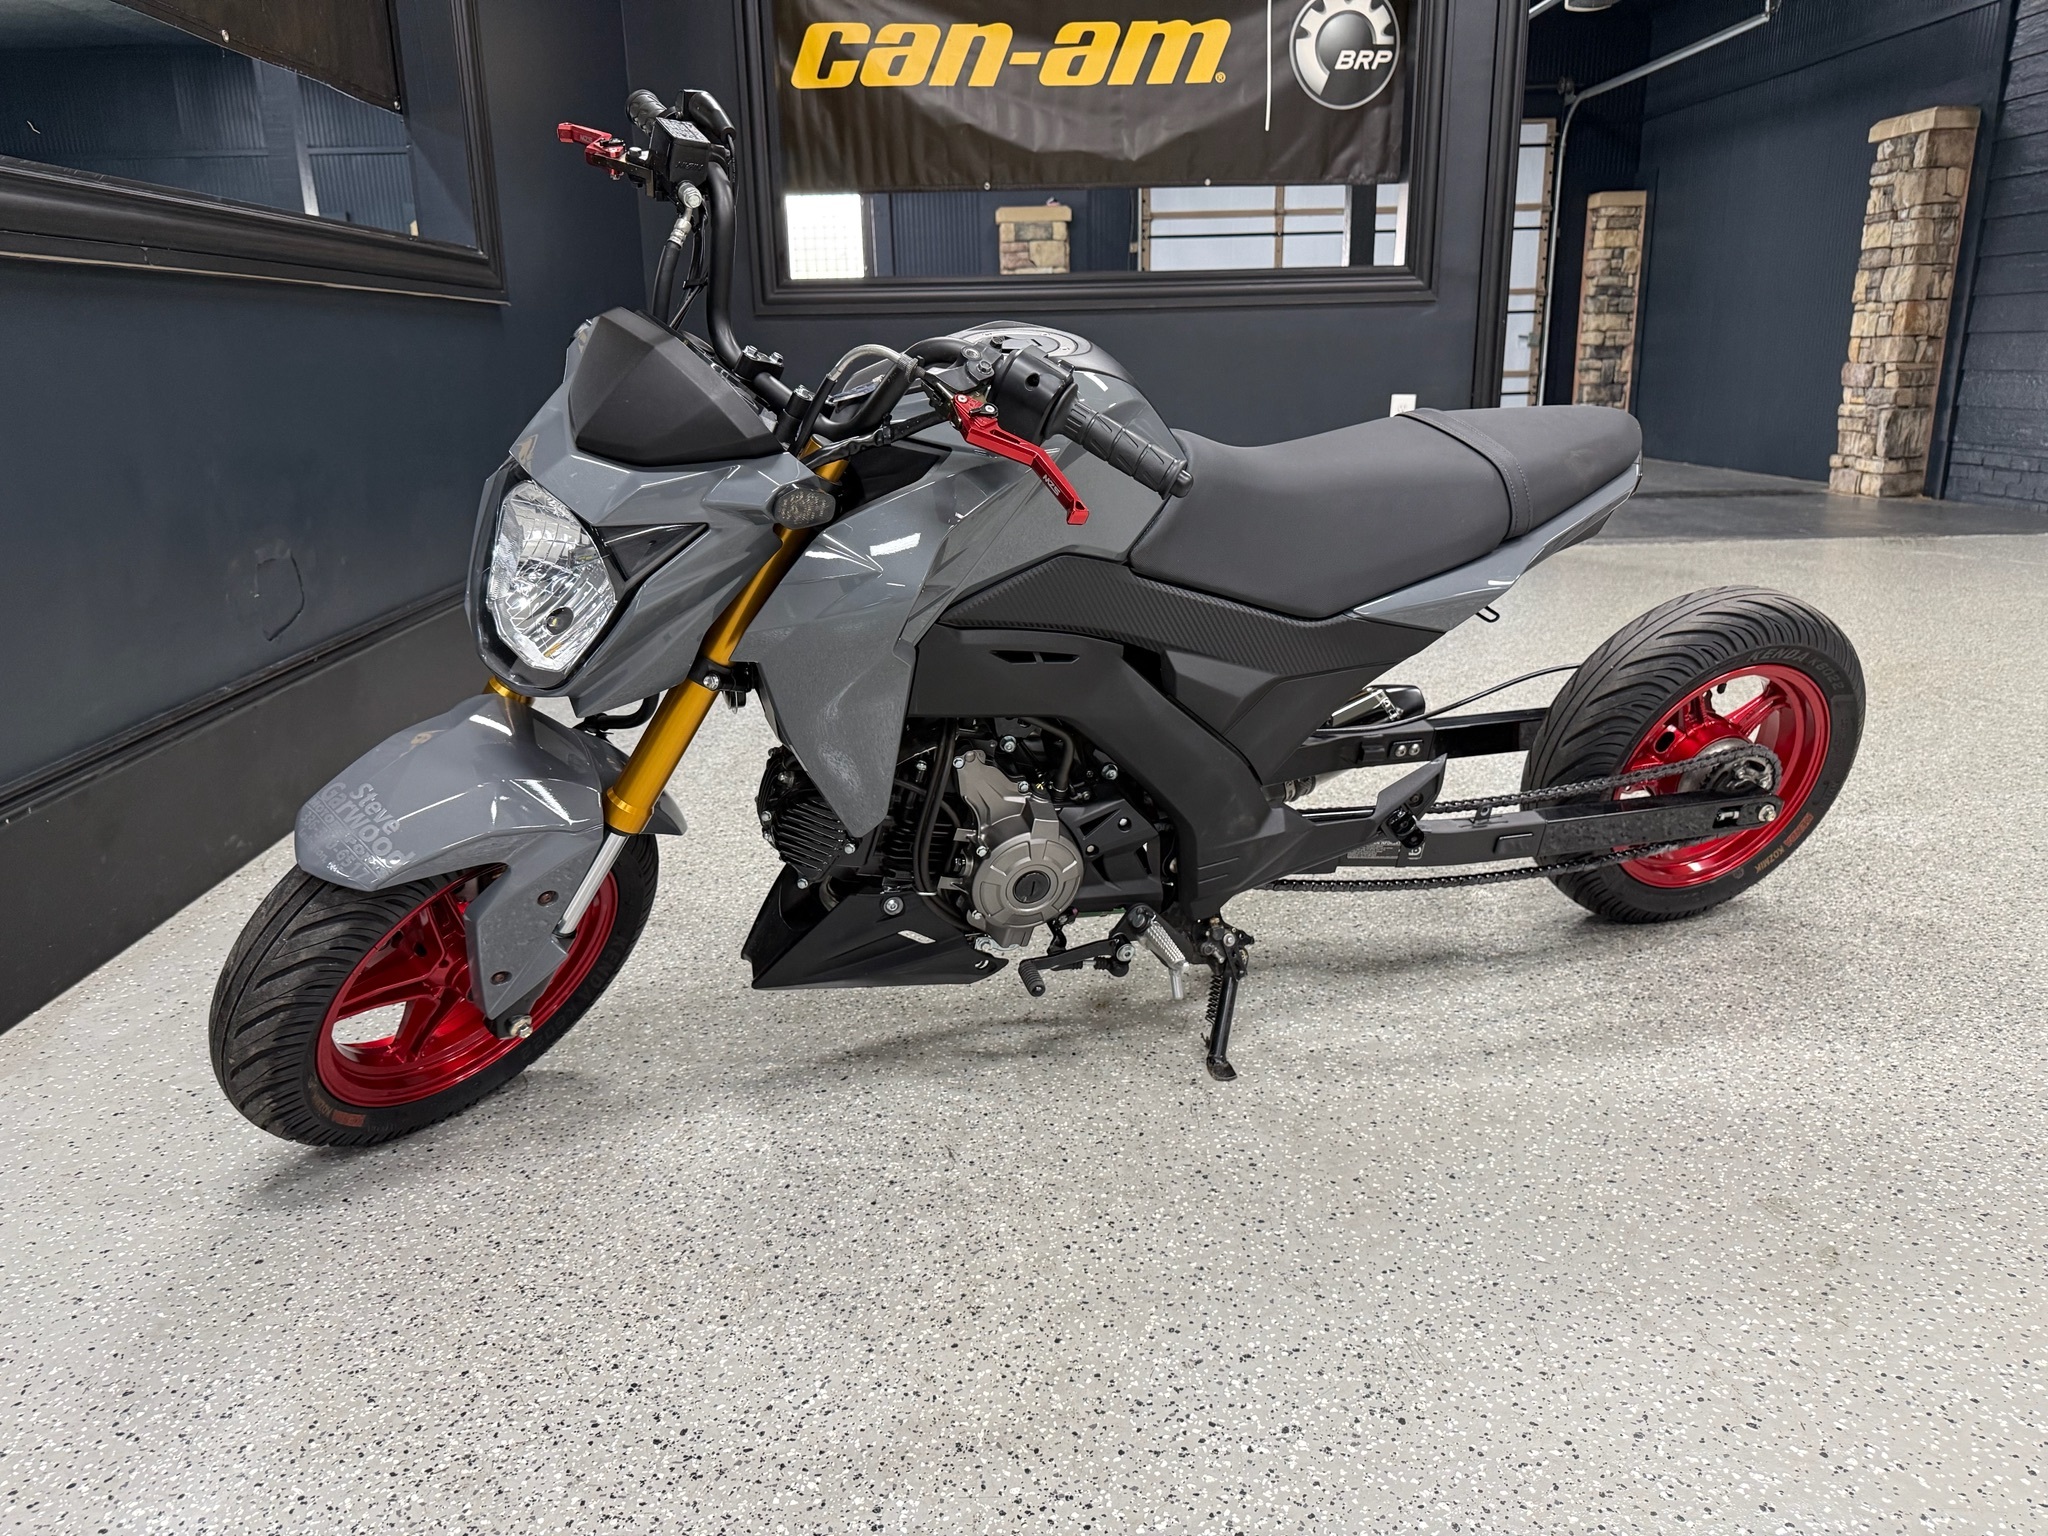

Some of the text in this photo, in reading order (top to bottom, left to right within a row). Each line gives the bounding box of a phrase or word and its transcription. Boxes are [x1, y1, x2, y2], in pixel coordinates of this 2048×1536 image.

[791, 19, 1232, 89] can-am
[1335, 49, 1393, 71] BRP
[1746, 648, 1810, 662] KENDA
[321, 782, 416, 868] Garwood
[349, 783, 401, 835] Steve
[1754, 845, 1785, 873] KOZMIK
